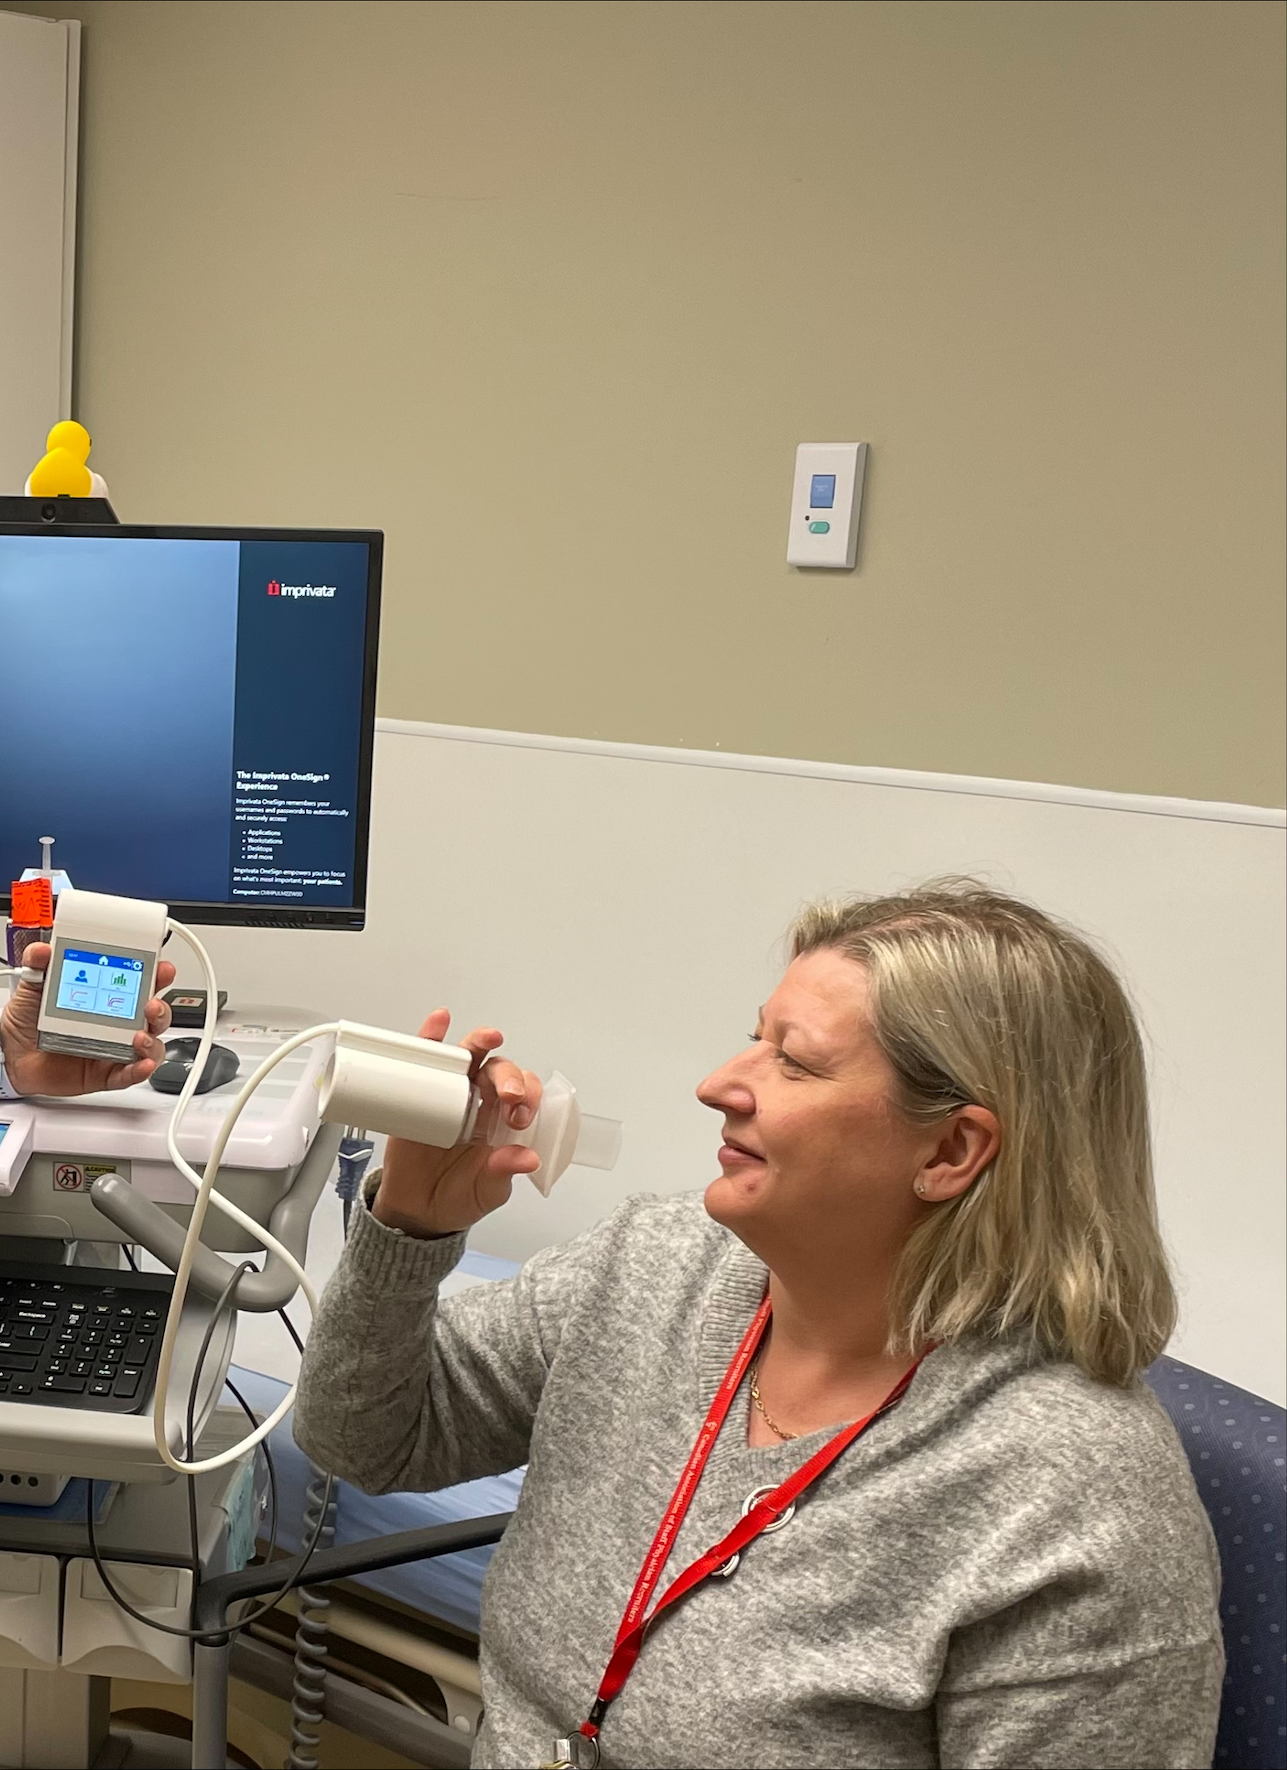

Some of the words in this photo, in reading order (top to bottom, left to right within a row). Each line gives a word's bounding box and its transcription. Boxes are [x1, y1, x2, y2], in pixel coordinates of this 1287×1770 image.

[236, 770, 251, 779] The
[252, 771, 290, 781] Imprivata
[236, 781, 279, 791] Experience
[247, 837, 284, 845] Workstations
[247, 845, 273, 853] Desktops
[689, 1433, 711, 1470] Canadian
[671, 1469, 695, 1514] Association
